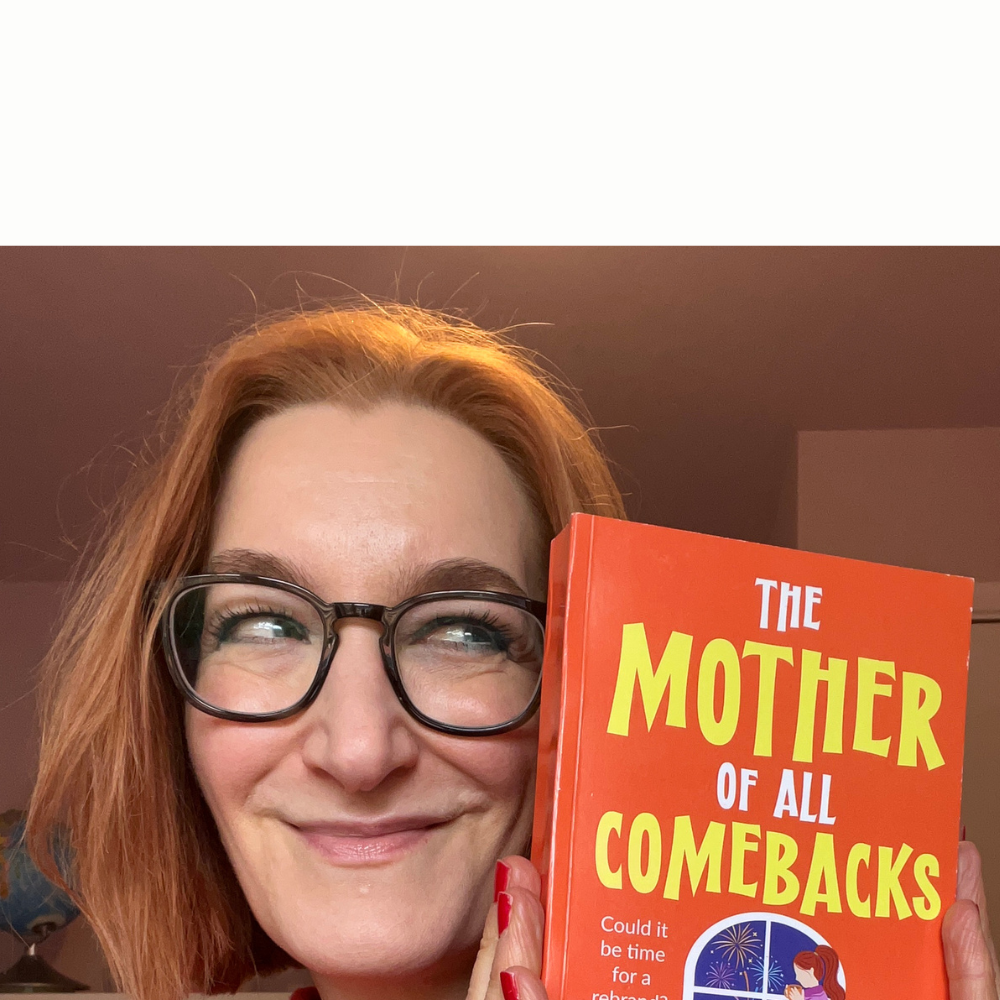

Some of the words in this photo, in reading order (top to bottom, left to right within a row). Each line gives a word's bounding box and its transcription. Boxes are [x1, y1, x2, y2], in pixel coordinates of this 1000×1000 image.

[754, 577, 823, 632] THE
[606, 622, 945, 771] MOTHER
[716, 762, 759, 812] OF
[772, 768, 837, 825] ALL
[595, 811, 942, 921] COMEBACKS
[600, 939, 622, 958] be
[627, 943, 666, 962] time
[601, 915, 652, 936] Could
[656, 921, 669, 938] it
[612, 966, 637, 984] for
[641, 973, 651, 985] a
